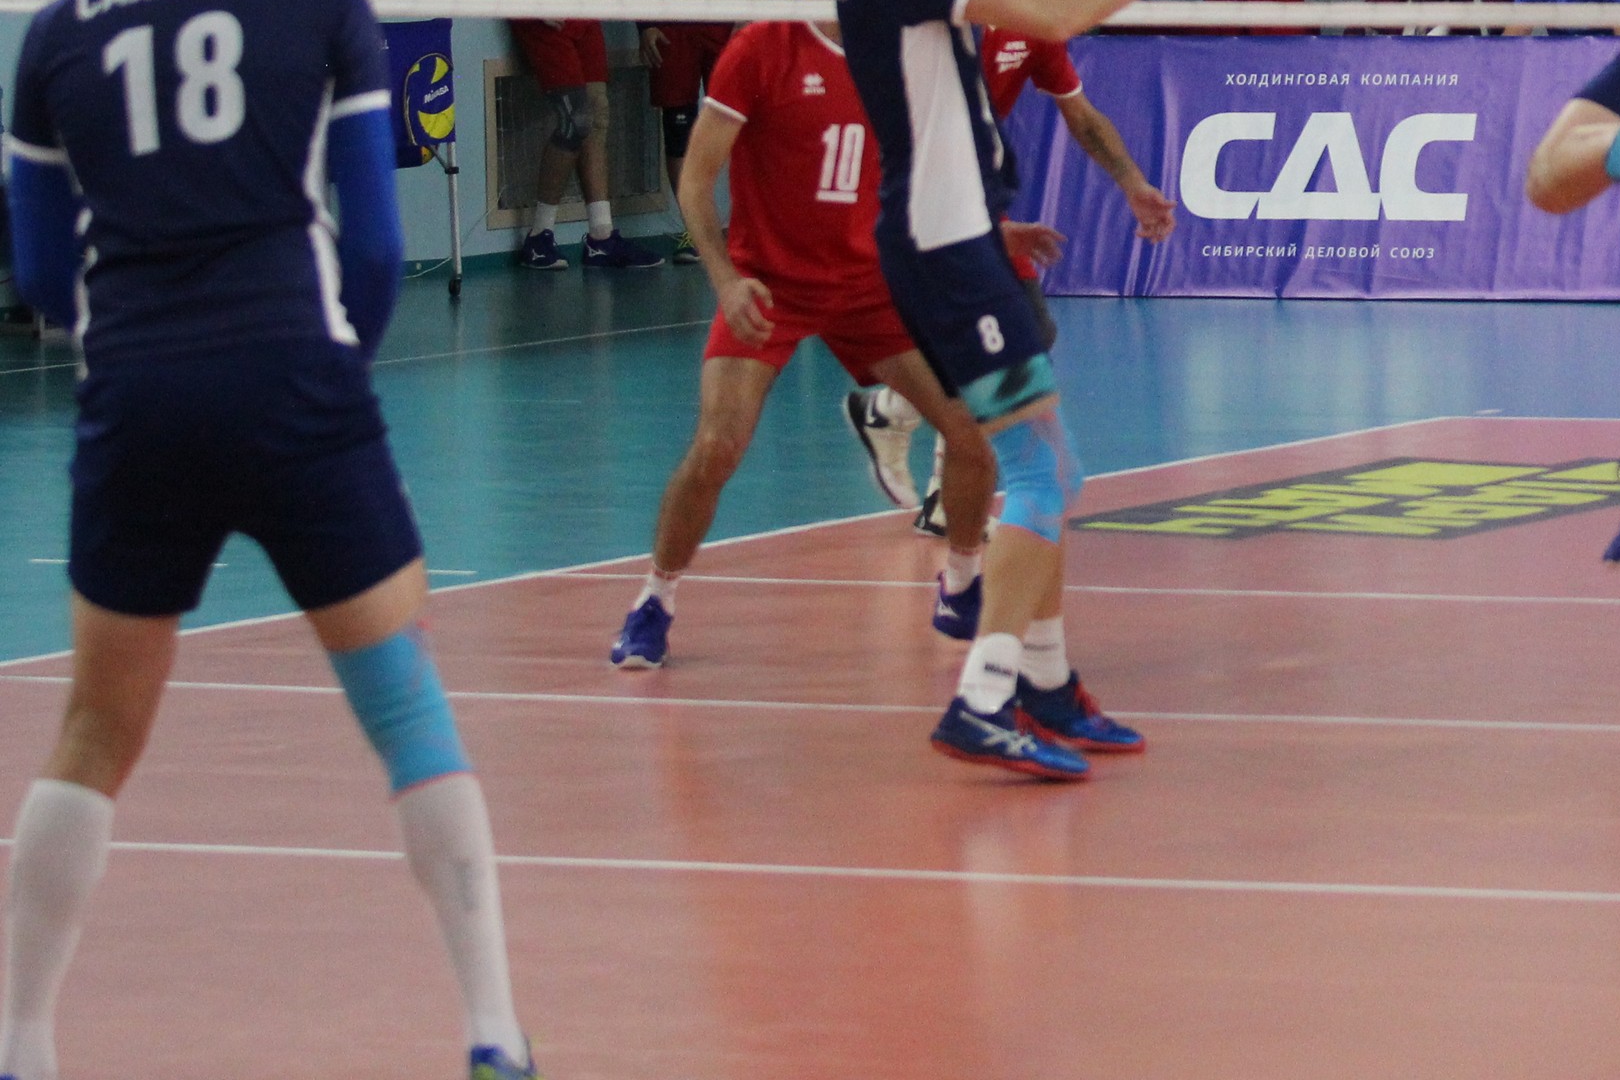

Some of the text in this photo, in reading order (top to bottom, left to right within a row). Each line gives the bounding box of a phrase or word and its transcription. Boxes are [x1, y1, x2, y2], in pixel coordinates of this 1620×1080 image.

[103, 10, 246, 157] 18
[1225, 73, 1459, 88] ХОЛДИНГОВАЯ КОМПАНИЯ
[820, 123, 866, 191] 10
[1202, 243, 1436, 260] СИБИРСКИЙ ДЕЛОВОЙ СОЮЗ
[977, 314, 1005, 354] 8
